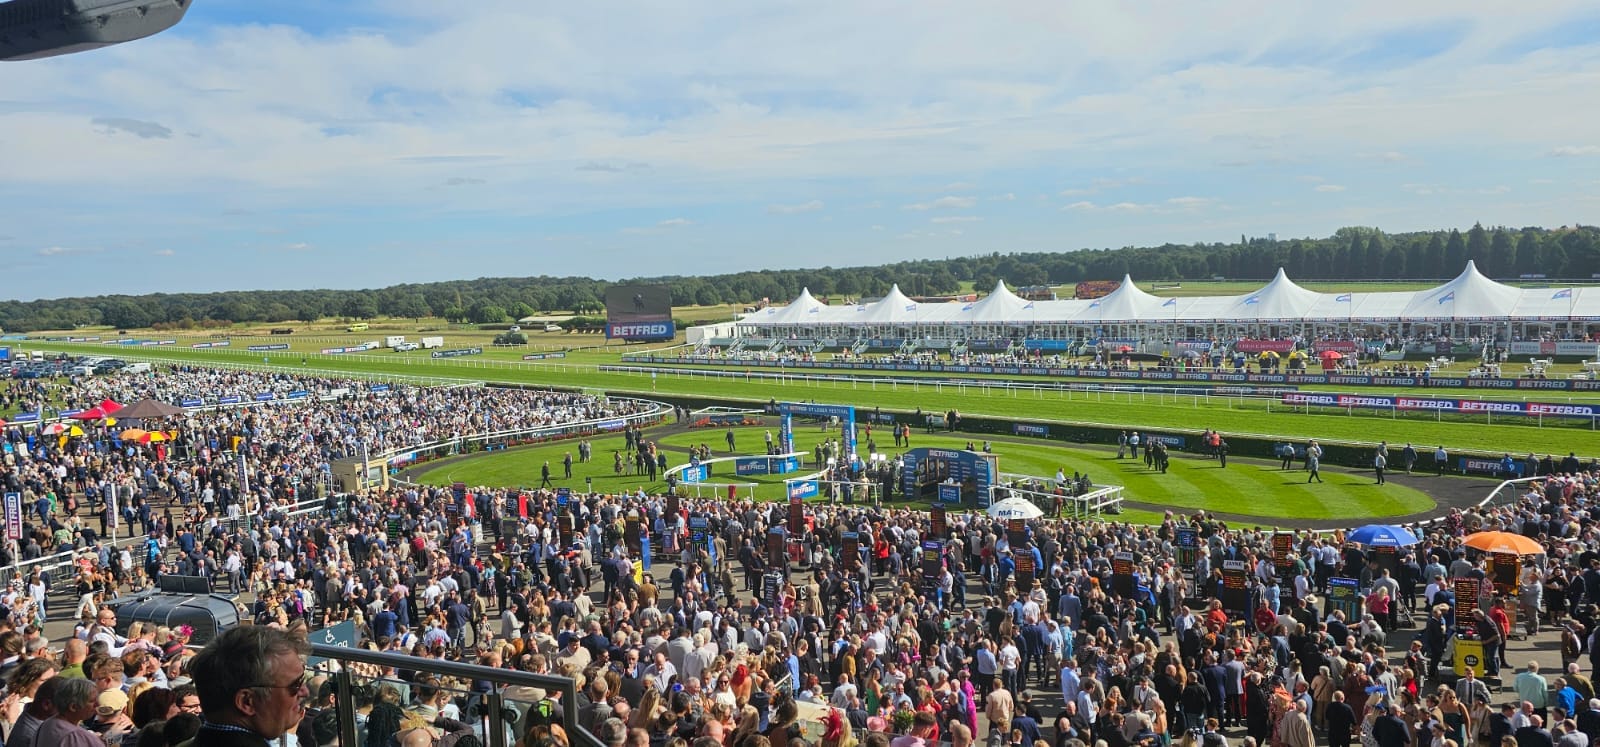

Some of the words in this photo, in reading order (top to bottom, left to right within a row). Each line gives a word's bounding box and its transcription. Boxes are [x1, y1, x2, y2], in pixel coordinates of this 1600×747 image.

[613, 325, 667, 336] BETFRED
[1286, 394, 1333, 404] BETFRED
[1340, 396, 1391, 406] BETFRED
[1400, 398, 1453, 409] BETFRED
[1462, 402, 1520, 412] BETFRED
[1530, 406, 1592, 415] BETFRED
[1018, 424, 1044, 433] BETFRED
[792, 485, 815, 496] BETFRED
[8, 496, 18, 537] BETFRED
